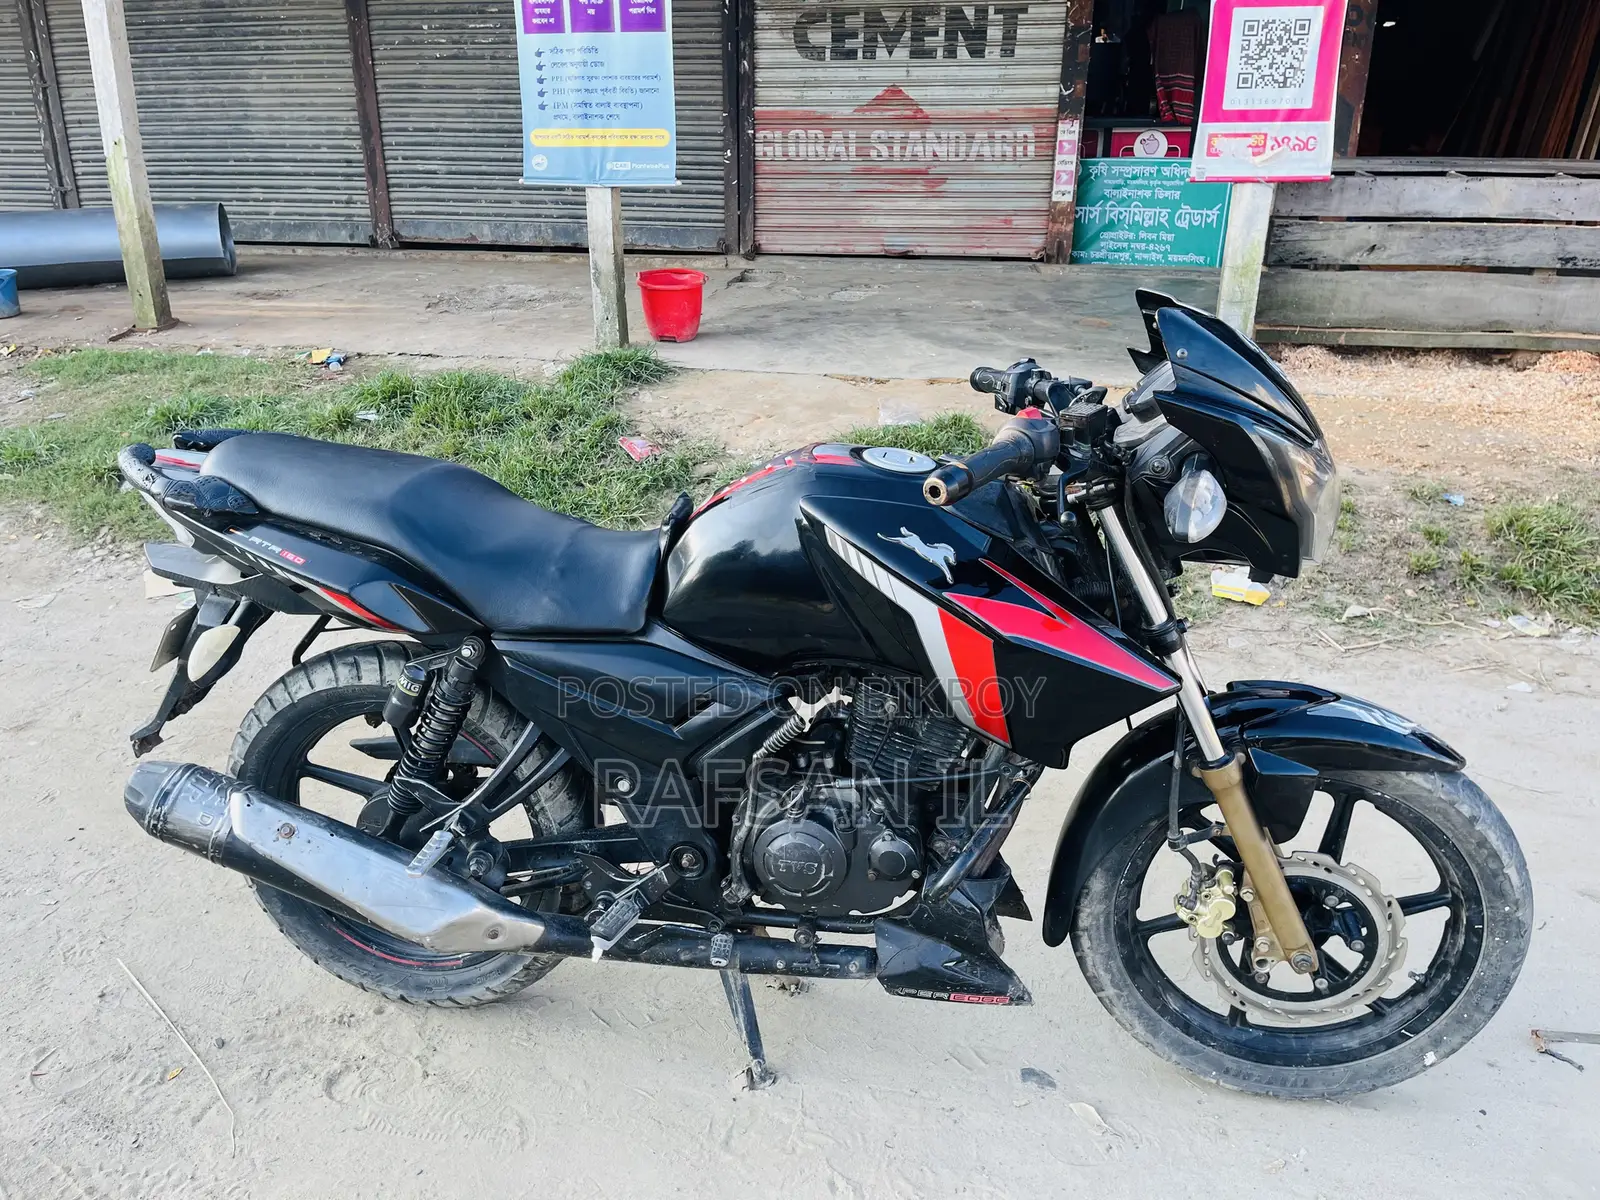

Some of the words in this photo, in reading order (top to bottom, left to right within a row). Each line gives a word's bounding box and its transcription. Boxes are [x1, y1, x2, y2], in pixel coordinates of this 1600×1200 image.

[793, 6, 1028, 61] CEMENT
[755, 129, 856, 161] GLOBAL
[870, 129, 1036, 161] STANDARD
[1088, 162, 1110, 180] কৃষি
[1111, 163, 1158, 178] সম্প্রসারণ
[1103, 186, 1153, 200] বালাইনাশক
[1154, 187, 1181, 200] ডিলার
[1075, 200, 1104, 226] সার্স
